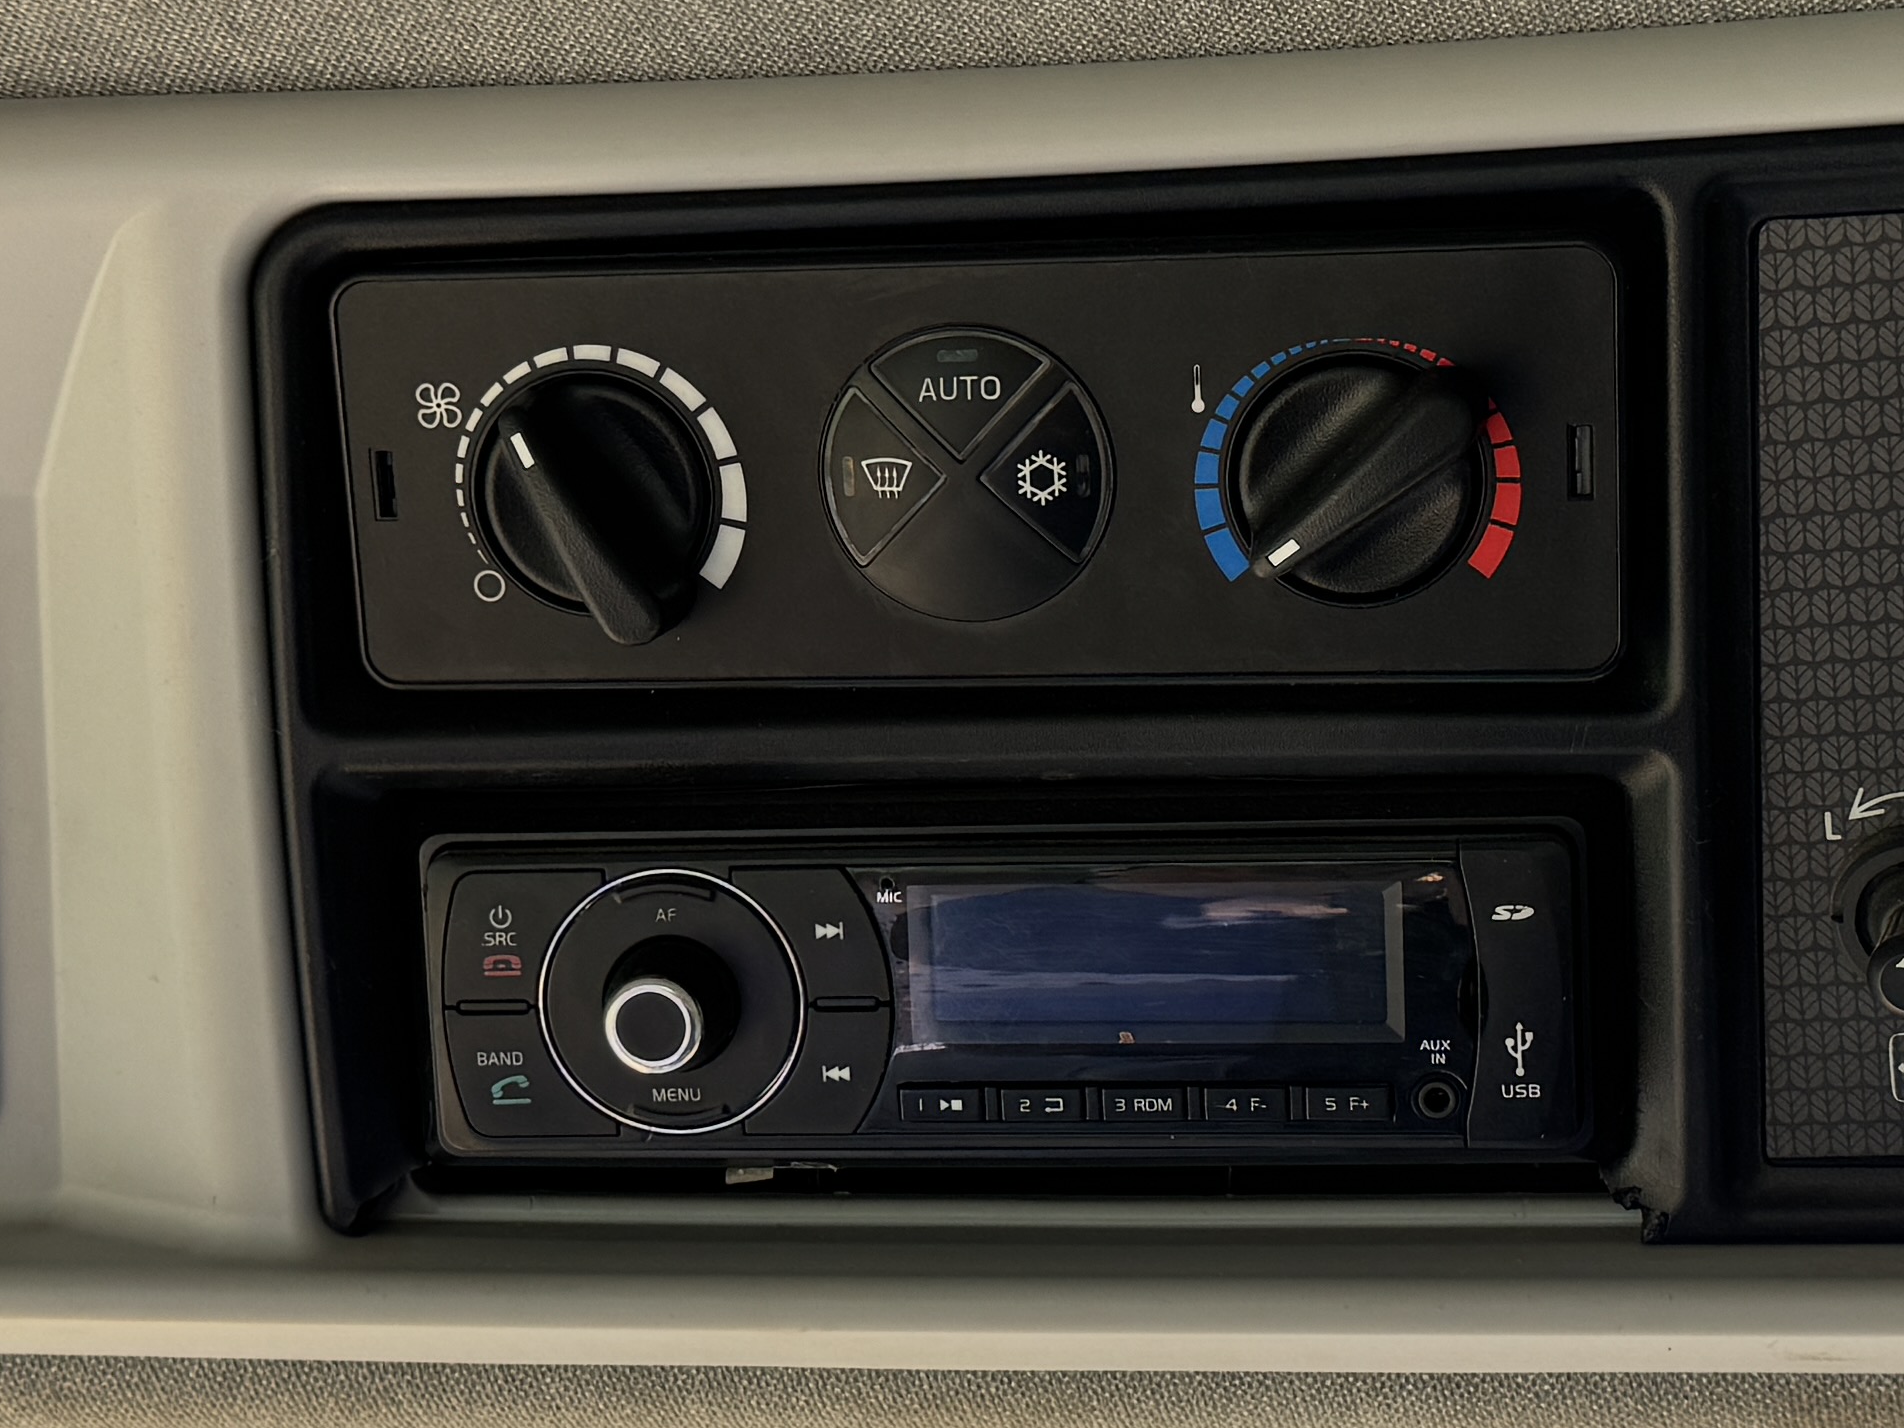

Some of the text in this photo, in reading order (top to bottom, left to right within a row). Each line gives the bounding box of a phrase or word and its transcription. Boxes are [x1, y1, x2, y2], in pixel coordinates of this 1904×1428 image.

[918, 375, 1001, 402] AUTO
[1824, 811, 1842, 840] L
[875, 890, 903, 904] MIC
[655, 908, 677, 922] AF
[484, 932, 517, 946] SRC
[1420, 1039, 1451, 1052] AUX
[477, 1051, 524, 1067] BAND
[1430, 1053, 1446, 1065] IN
[652, 1087, 701, 1102] MENU
[1501, 1084, 1541, 1099] USB
[1019, 1099, 1031, 1112] 2
[1114, 1098, 1173, 1113] 3 RDM
[1325, 1097, 1370, 1112] 5 F+
